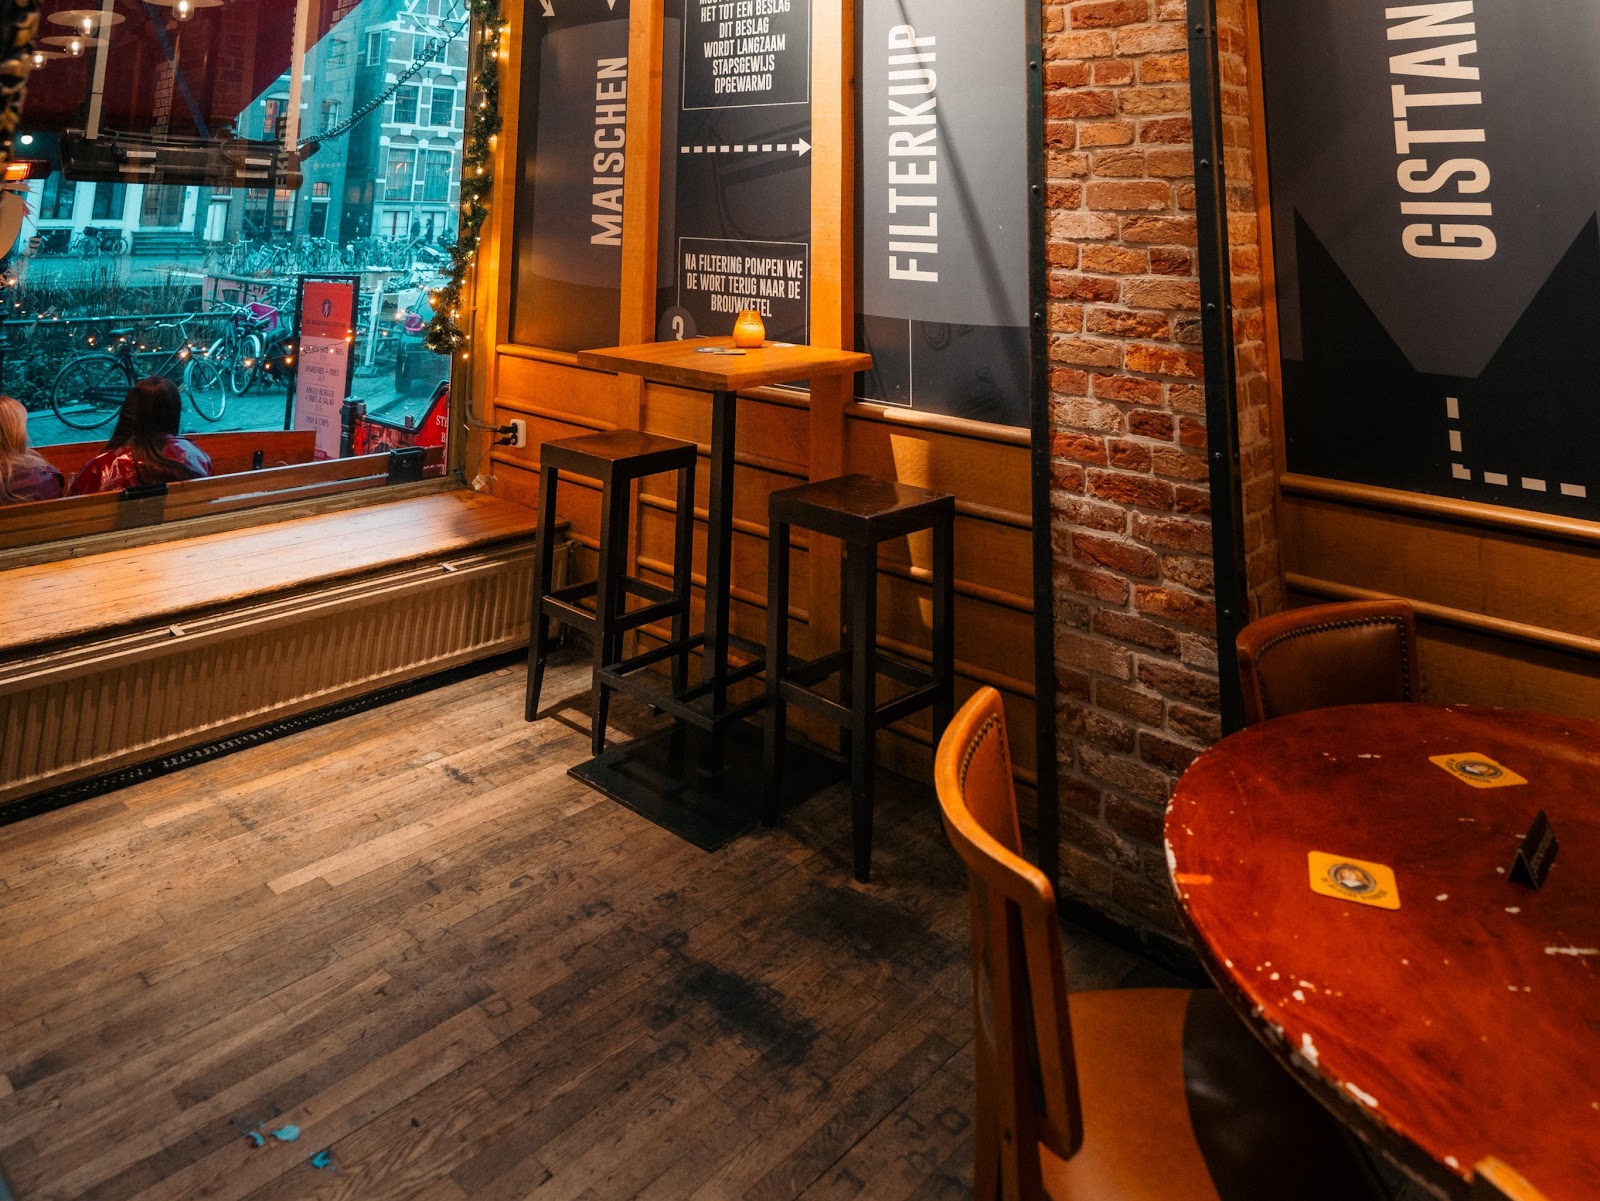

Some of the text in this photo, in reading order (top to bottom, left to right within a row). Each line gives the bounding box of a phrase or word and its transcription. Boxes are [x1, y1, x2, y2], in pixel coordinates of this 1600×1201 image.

[701, 6, 715, 23] HET
[719, 3, 734, 19] TOT
[737, 0, 753, 17] EEN
[719, 17, 769, 39] DIT BESLAG
[704, 34, 785, 58] WORDT LANGZAAM
[713, 54, 775, 76] STAPSGEWIJS
[715, 74, 772, 94] OPGEWARMD
[591, 57, 627, 246] MAISCHEN
[888, 24, 938, 283] FILTERKUIP
[685, 253, 803, 278] NA FILTERING POMPEN WE
[687, 273, 800, 299] DE WORT TERUG NAAR DE
[711, 294, 772, 317] BROUWKETEL
